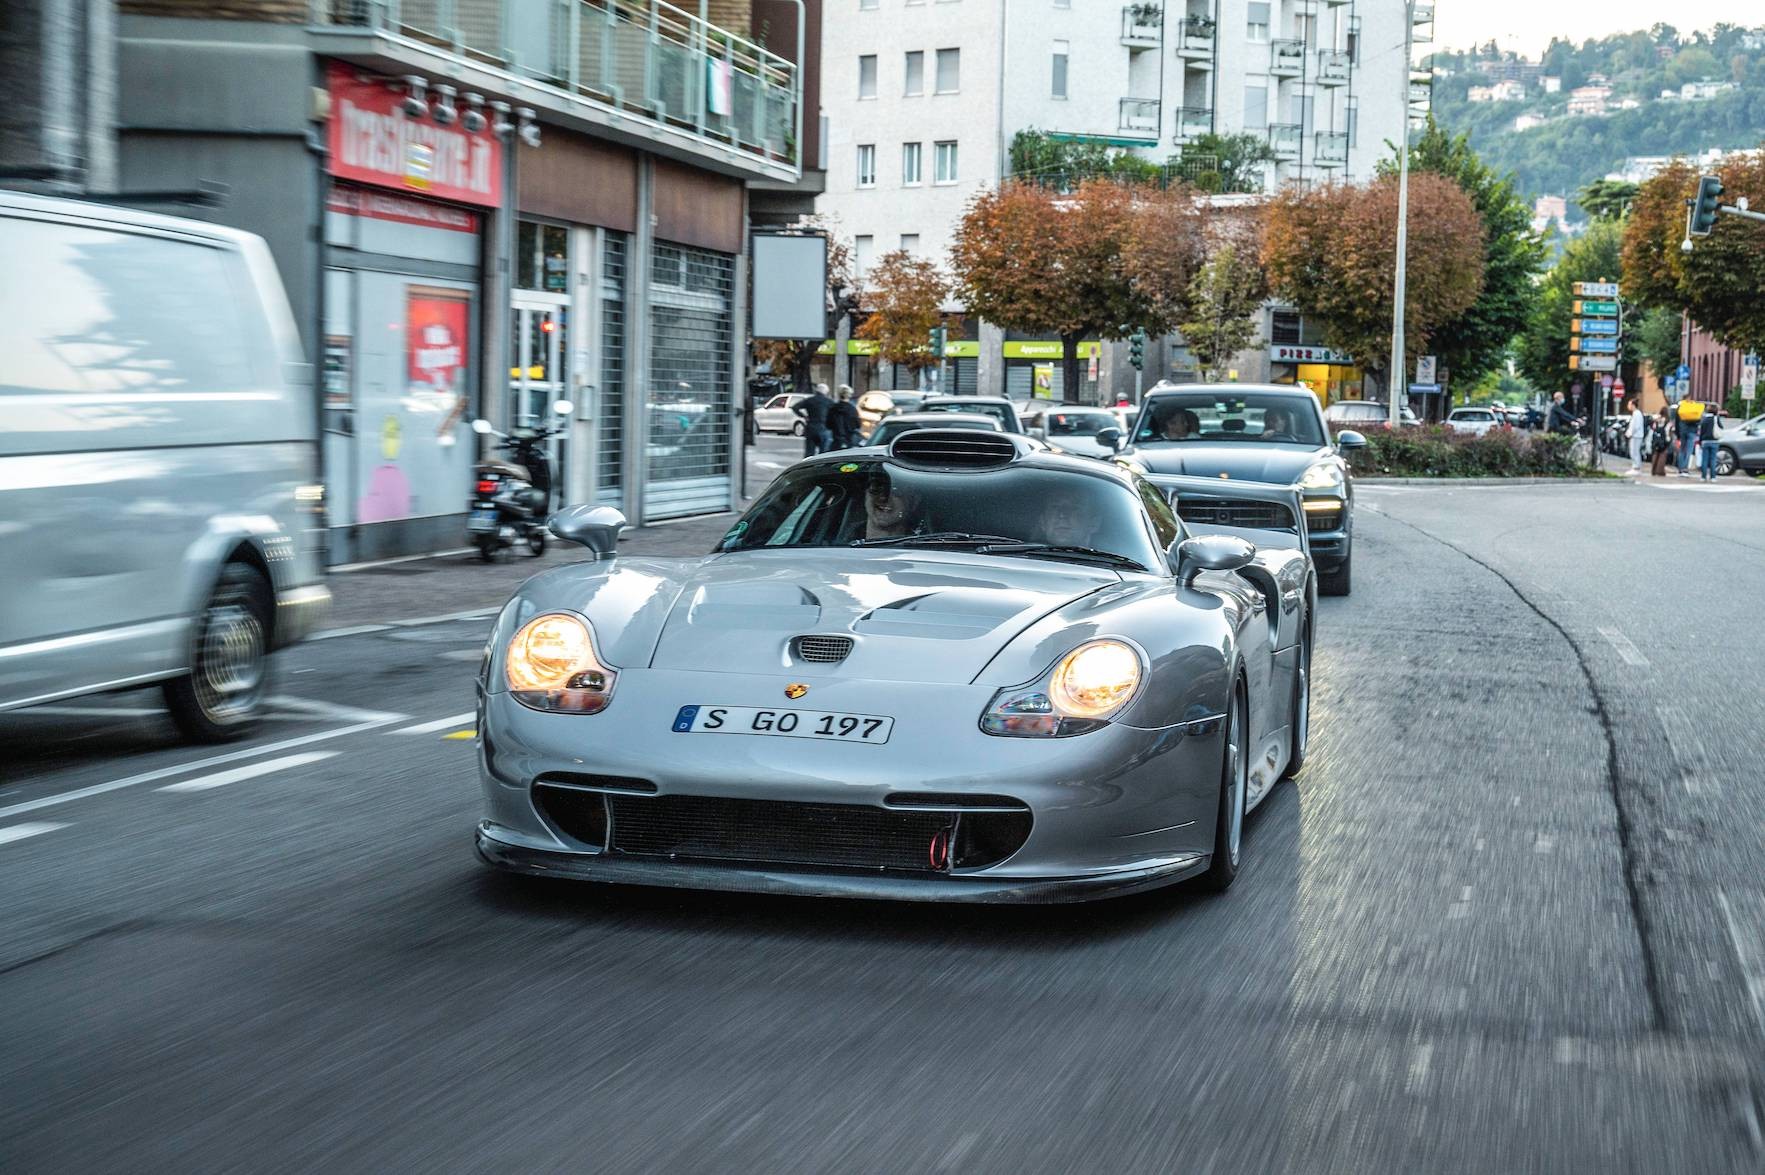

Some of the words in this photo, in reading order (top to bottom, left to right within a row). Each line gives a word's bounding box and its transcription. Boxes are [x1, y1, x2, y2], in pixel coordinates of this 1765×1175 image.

[679, 722, 688, 730] D
[703, 709, 728, 729] S
[751, 711, 799, 733] GO
[814, 715, 883, 739] 197
